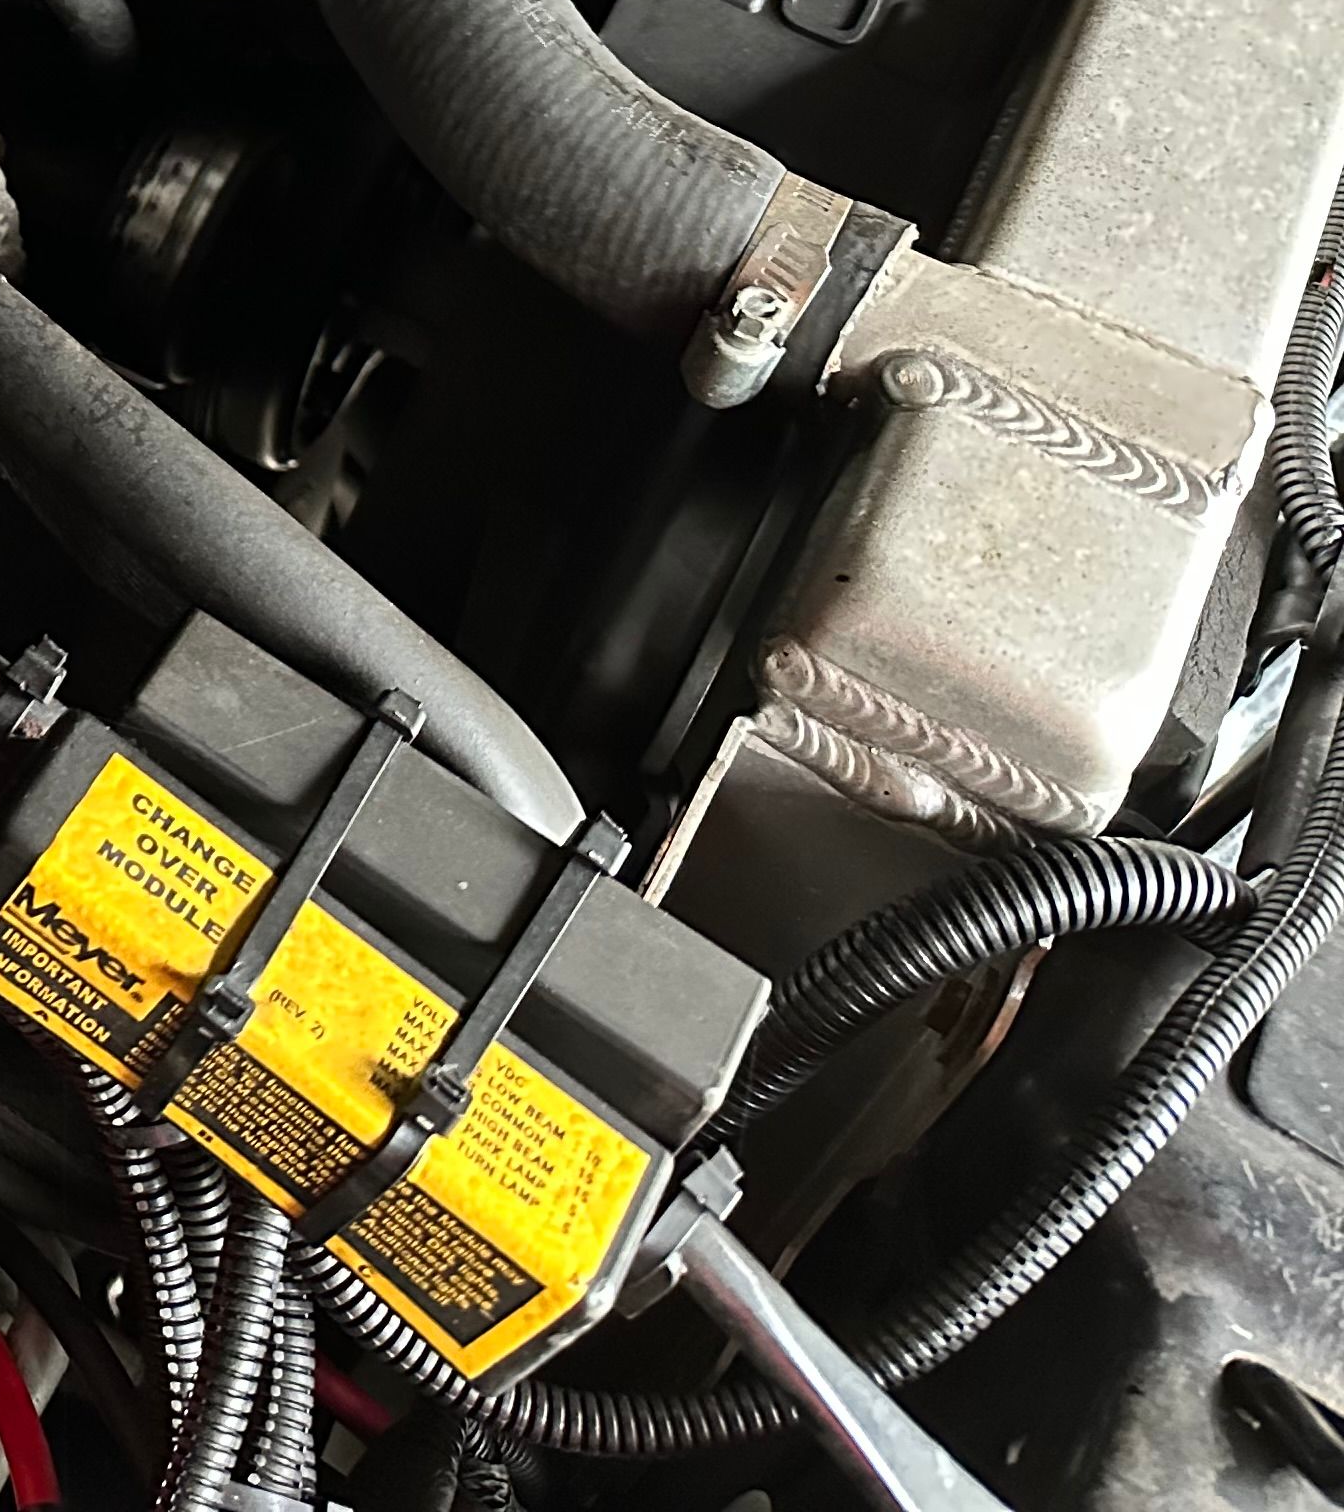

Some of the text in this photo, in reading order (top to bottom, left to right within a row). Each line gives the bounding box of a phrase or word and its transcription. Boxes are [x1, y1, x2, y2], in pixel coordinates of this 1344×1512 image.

[128, 790, 257, 895] CHANGE
[133, 830, 221, 904] OVER
[96, 838, 225, 944] MODULE
[0, 926, 108, 1013] IMPORTANT
[238, 1100, 270, 1127] and
[470, 1107, 511, 1142] HIGH
[511, 1138, 555, 1176] BEAM
[478, 1090, 547, 1148] COMMON
[485, 1075, 522, 1107] LOW
[523, 1103, 567, 1141] BEAM
[194, 1082, 225, 1107] and
[222, 1102, 257, 1132] then
[254, 1128, 309, 1173] replace
[360, 1215, 435, 1278] Additional
[215, 1110, 242, 1134] the
[348, 1219, 394, 1259] ystem
[239, 1056, 269, 1082] not
[264, 1076, 327, 1127] function
[411, 1192, 440, 1218] the
[436, 1212, 494, 1261] Module
[488, 1255, 526, 1289] may
[252, 1084, 330, 1147] determine
[324, 1139, 355, 1167] the
[411, 1210, 451, 1244] such
[447, 1238, 496, 1280] failure
[453, 1138, 497, 1176] TURN
[497, 1173, 541, 1210] LAMP
[461, 1122, 504, 1159] PARK
[504, 1156, 547, 1193] LAMP
